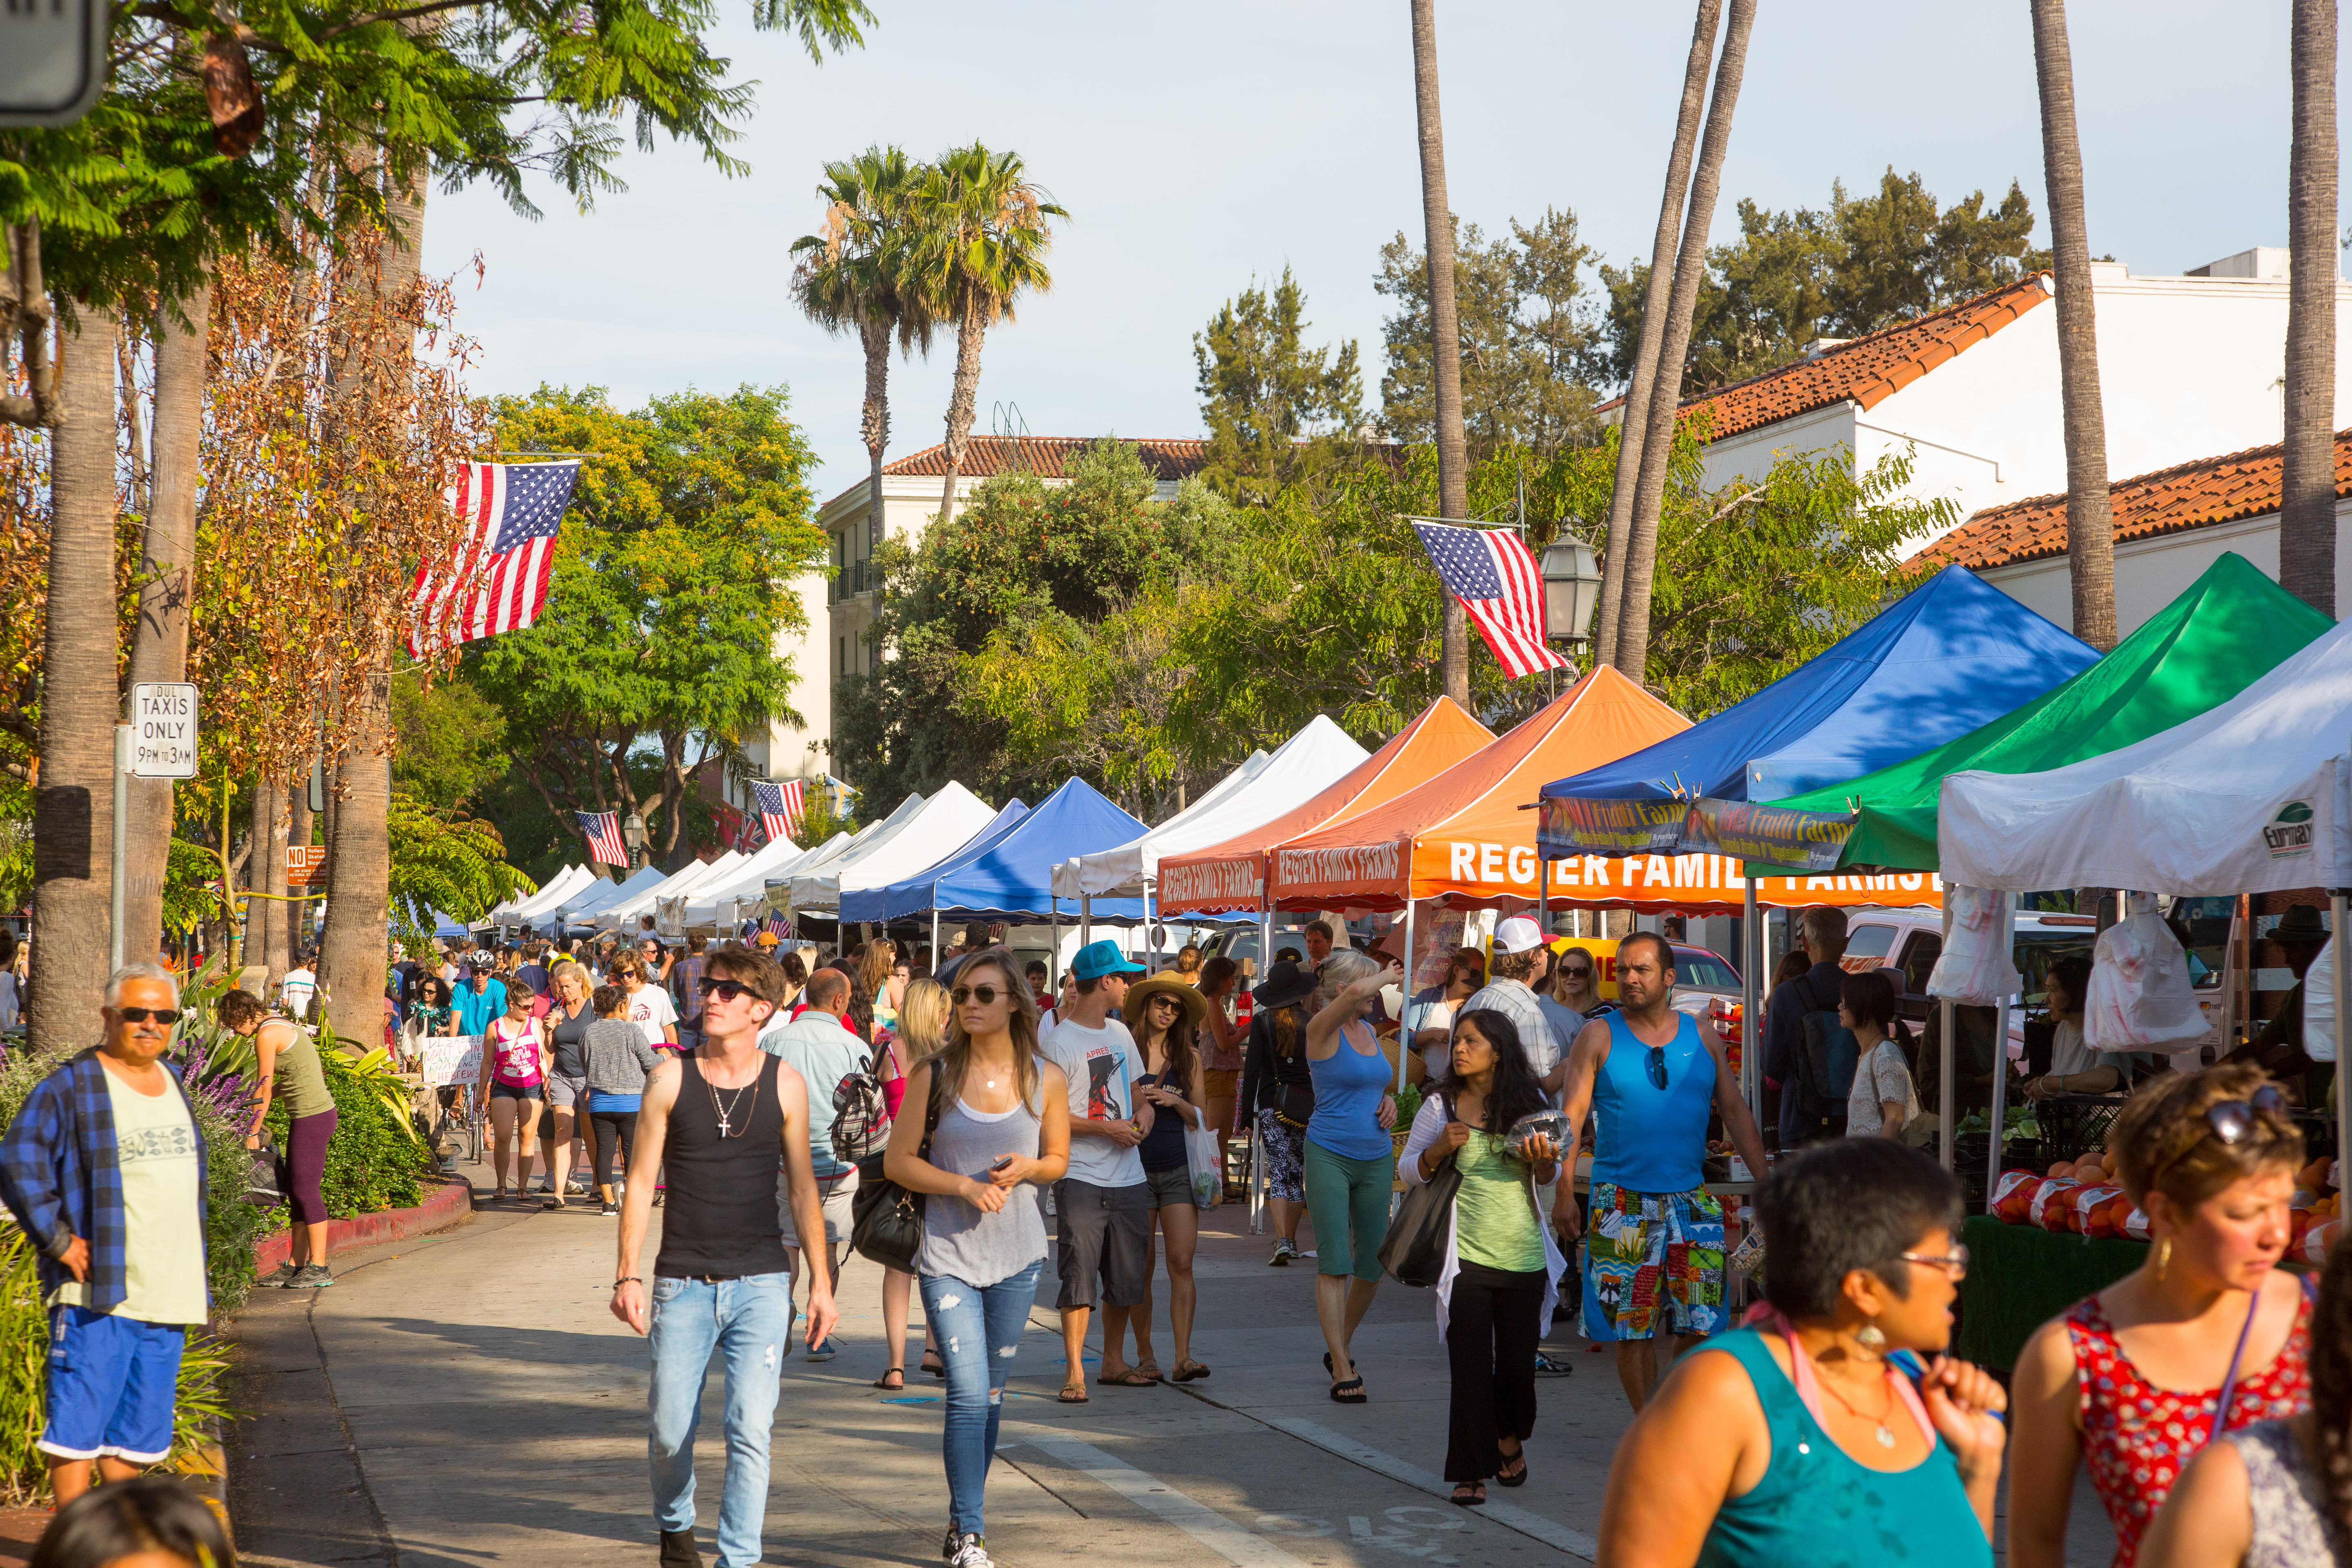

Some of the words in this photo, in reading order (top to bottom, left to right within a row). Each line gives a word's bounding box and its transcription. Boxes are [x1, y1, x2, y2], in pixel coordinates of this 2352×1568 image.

[142, 698, 187, 715] TAXIS
[144, 722, 185, 738] ONLY
[138, 746, 158, 763] 9PM
[162, 752, 168, 761] TO
[170, 747, 190, 764] 3AM
[1592, 802, 1636, 827] Frutti
[1635, 803, 1687, 825] Farm
[1719, 804, 1752, 833] Tutti
[1749, 808, 1798, 840] Frutti
[288, 849, 303, 865] NO
[1767, 842, 1809, 862] Vegetables
[1279, 849, 1318, 885] REGIER
[1317, 846, 1360, 883] FAMILY
[1358, 841, 1401, 880] FARMS
[1450, 842, 1610, 886] REGER
[1163, 866, 1193, 903] REGIER
[1191, 862, 1223, 900] FAMILY
[1221, 860, 1254, 898] FARMS
[1439, 962, 1449, 972] 1985
[429, 1035, 482, 1049] DISABLED
[425, 1046, 454, 1061] DONT
[429, 1061, 473, 1073] ANYTHING
